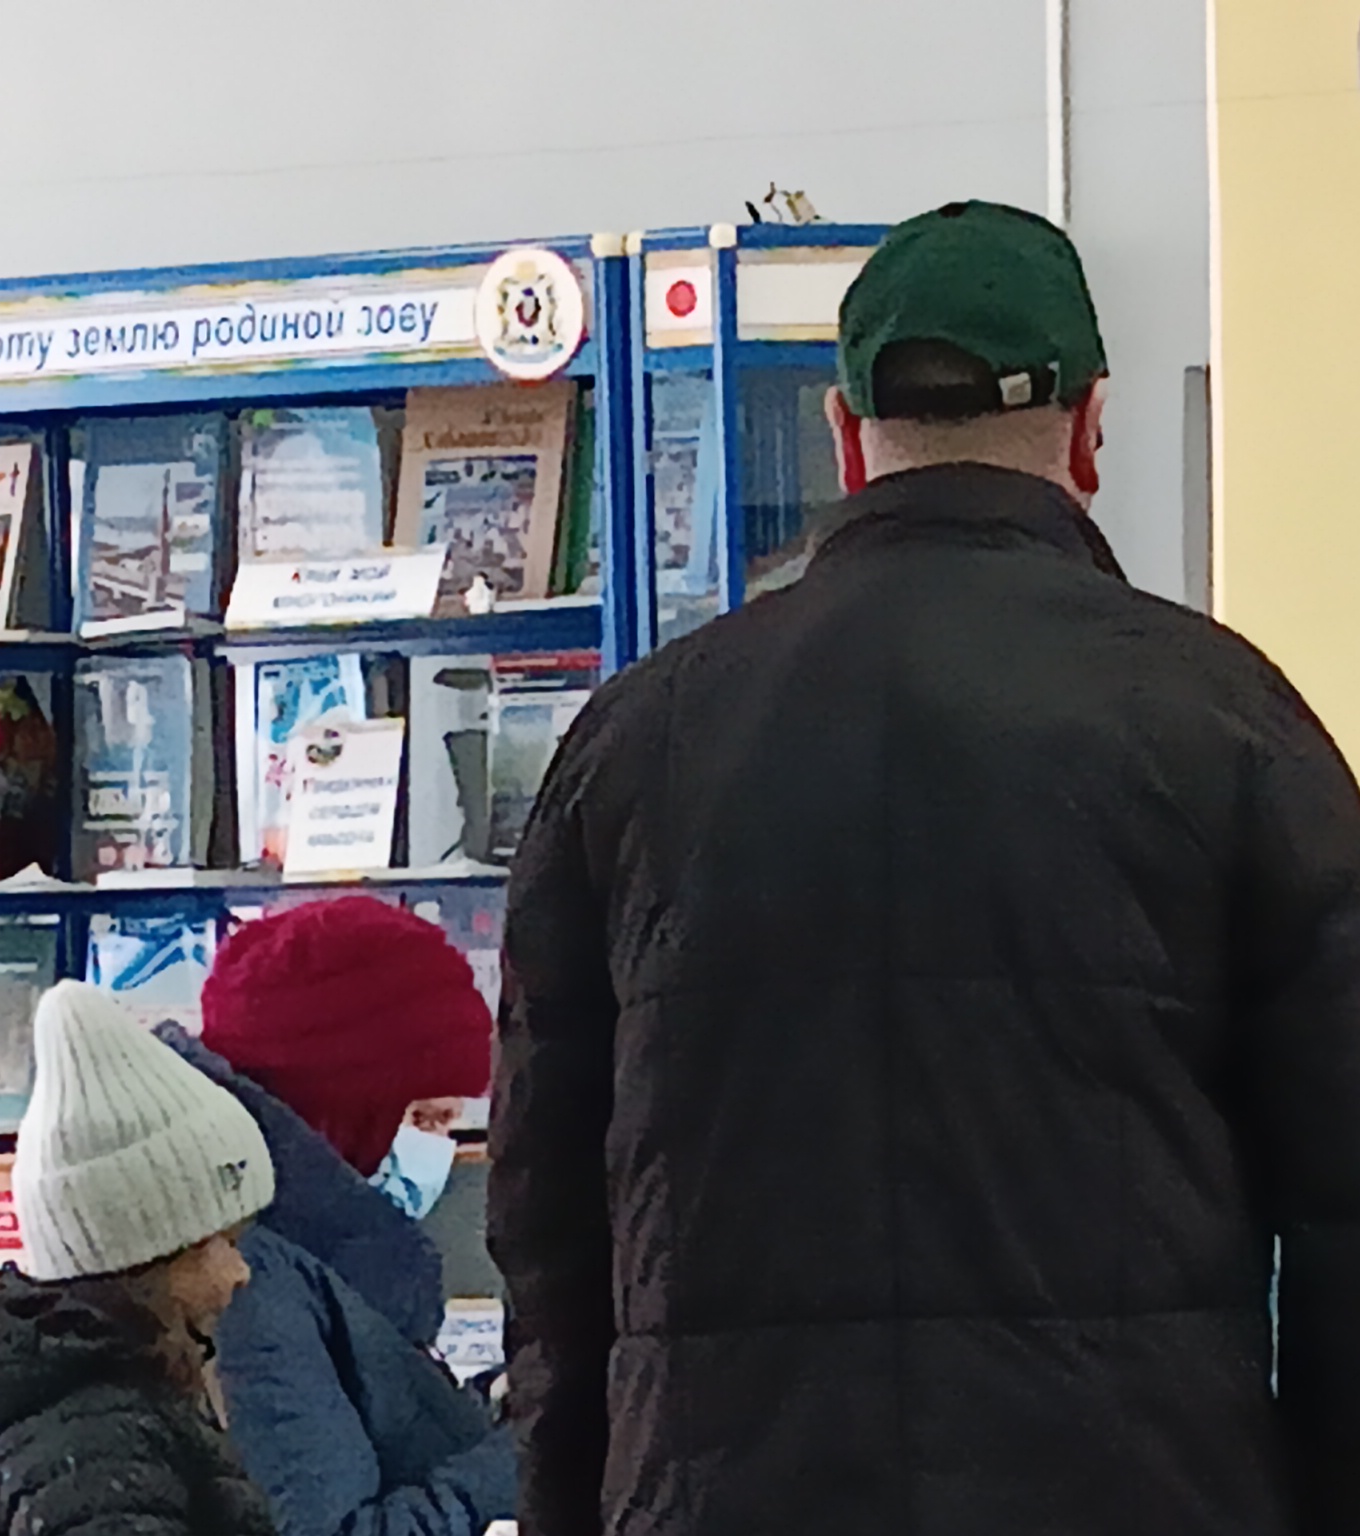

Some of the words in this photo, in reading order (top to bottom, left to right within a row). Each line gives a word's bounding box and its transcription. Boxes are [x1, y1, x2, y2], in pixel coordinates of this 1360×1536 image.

[66, 320, 180, 358] землю
[192, 299, 344, 356] родиной
[357, 302, 438, 342] зову
